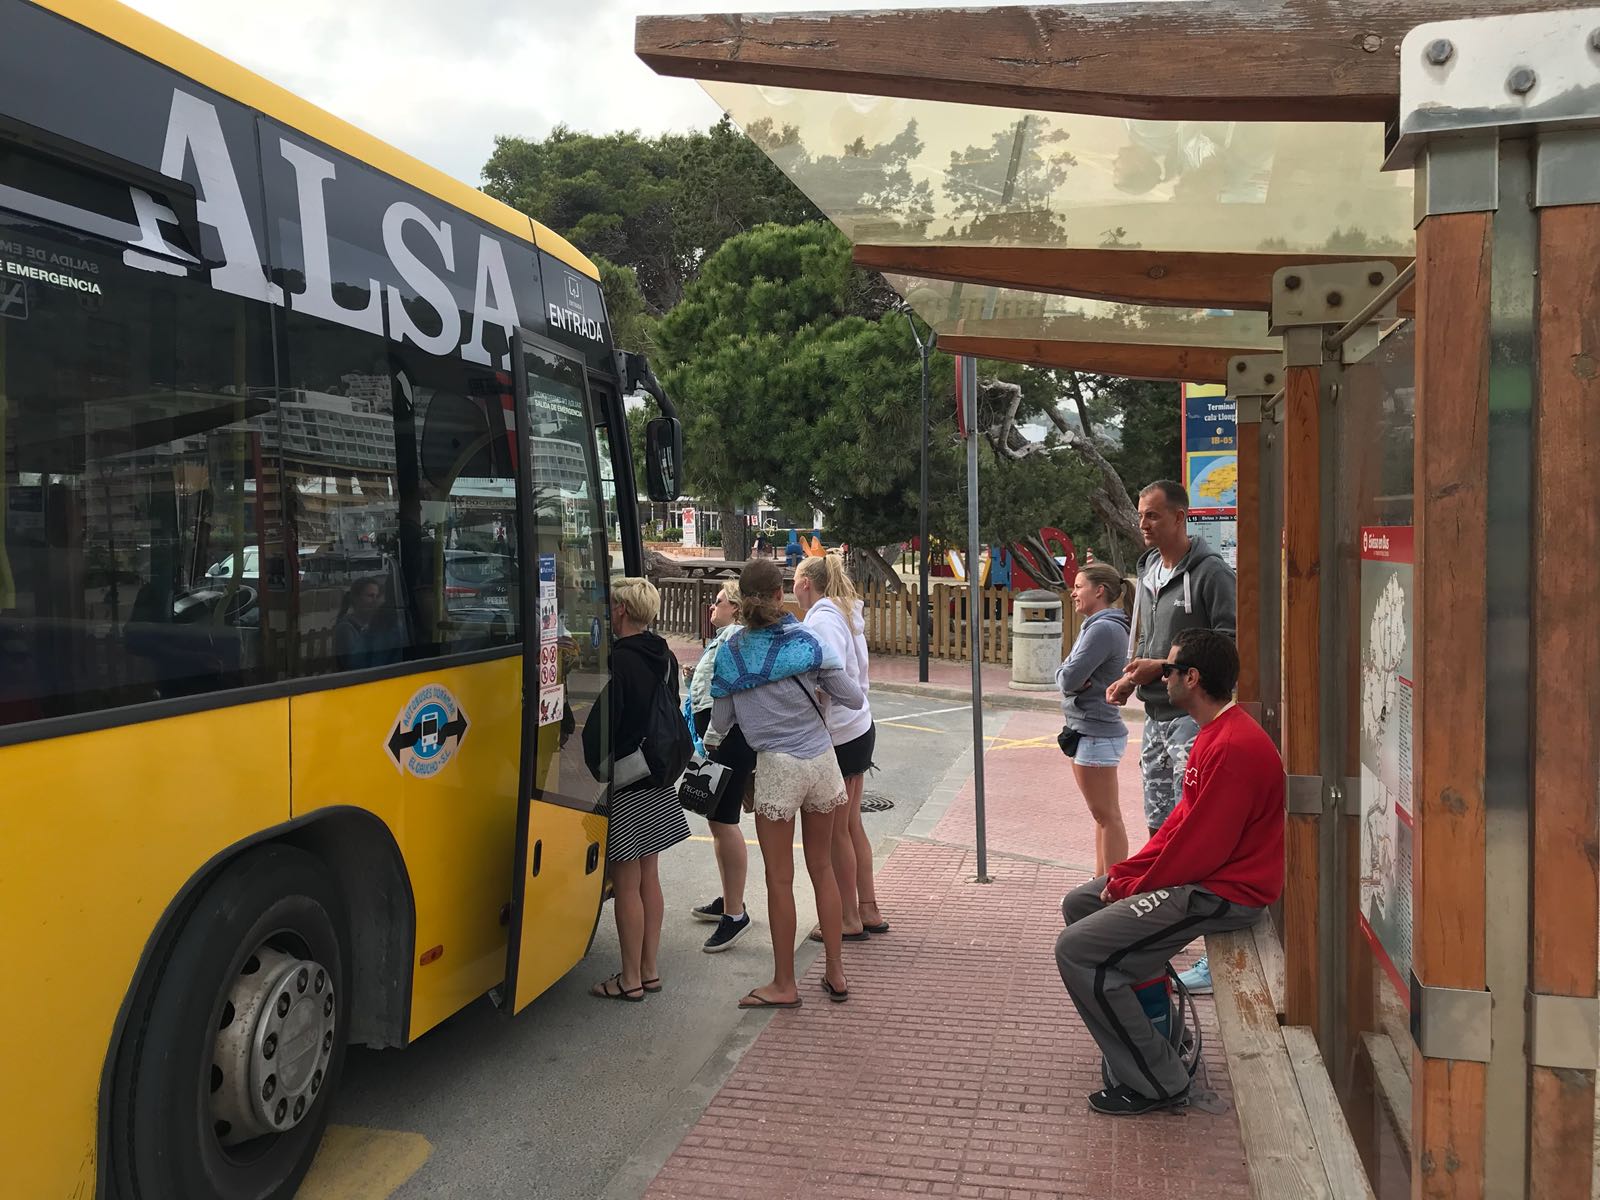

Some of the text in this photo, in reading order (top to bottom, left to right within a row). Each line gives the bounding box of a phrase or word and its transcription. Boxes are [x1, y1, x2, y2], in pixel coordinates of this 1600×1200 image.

[122, 87, 521, 372] ALSA
[6, 261, 102, 295] EMERGENCIA
[549, 302, 604, 344] ENTRADA
[1204, 414, 1217, 422] cala
[1207, 402, 1236, 411] Terminal
